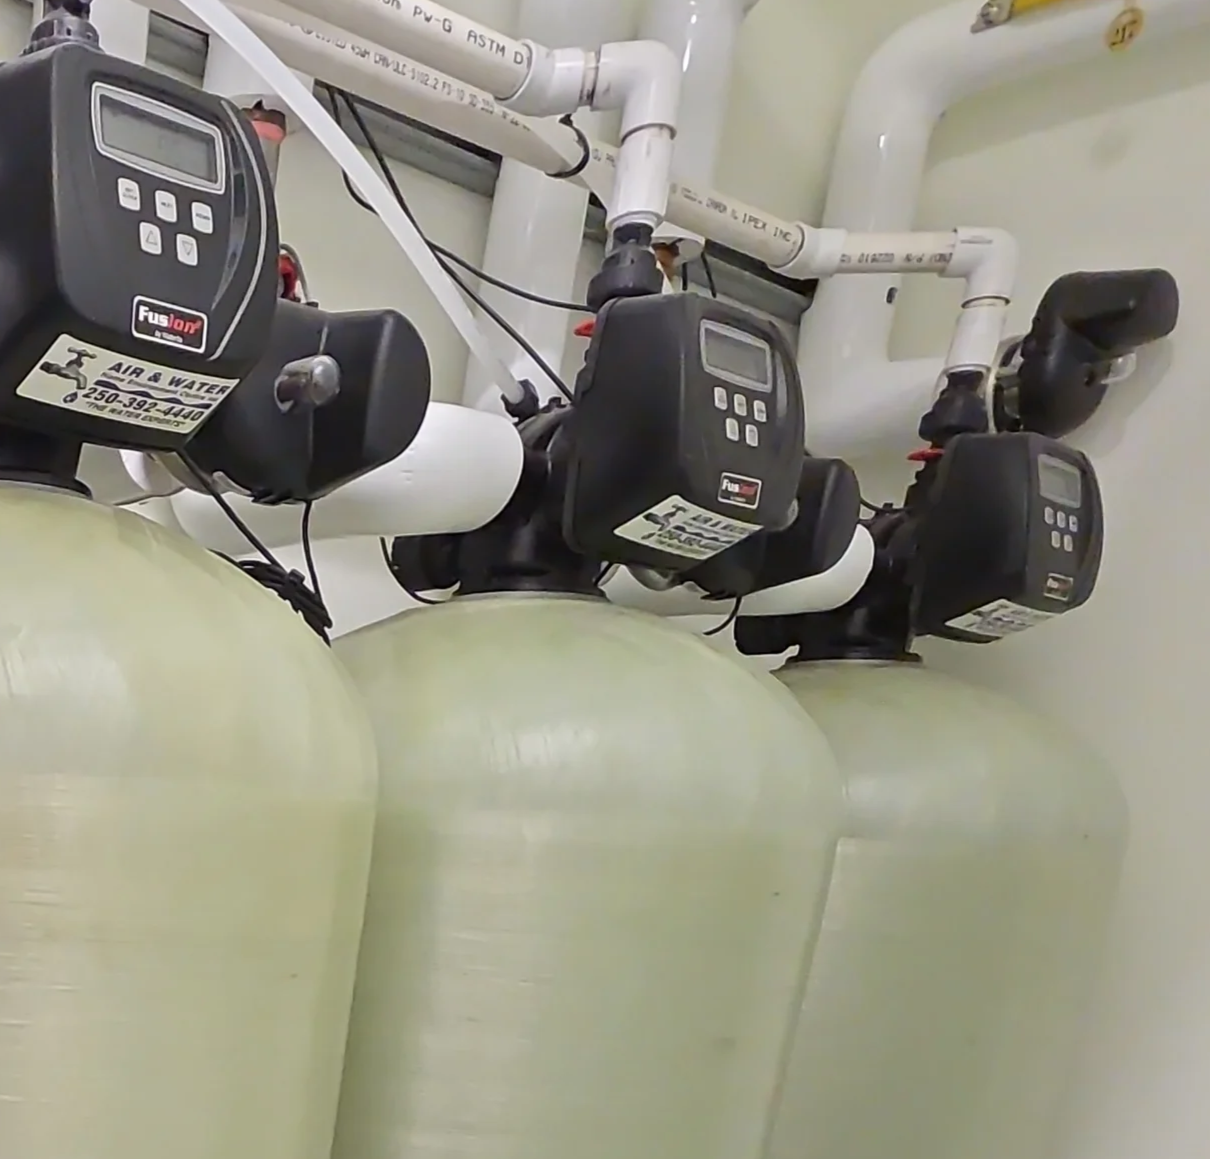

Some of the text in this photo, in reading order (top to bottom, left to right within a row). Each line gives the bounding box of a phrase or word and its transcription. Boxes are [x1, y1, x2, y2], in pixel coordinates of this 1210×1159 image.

[467, 30, 506, 58] ASTM
[742, 213, 768, 233] IPEX
[108, 361, 231, 396] AIR & WATER
[82, 387, 205, 422] 250-392-4440
